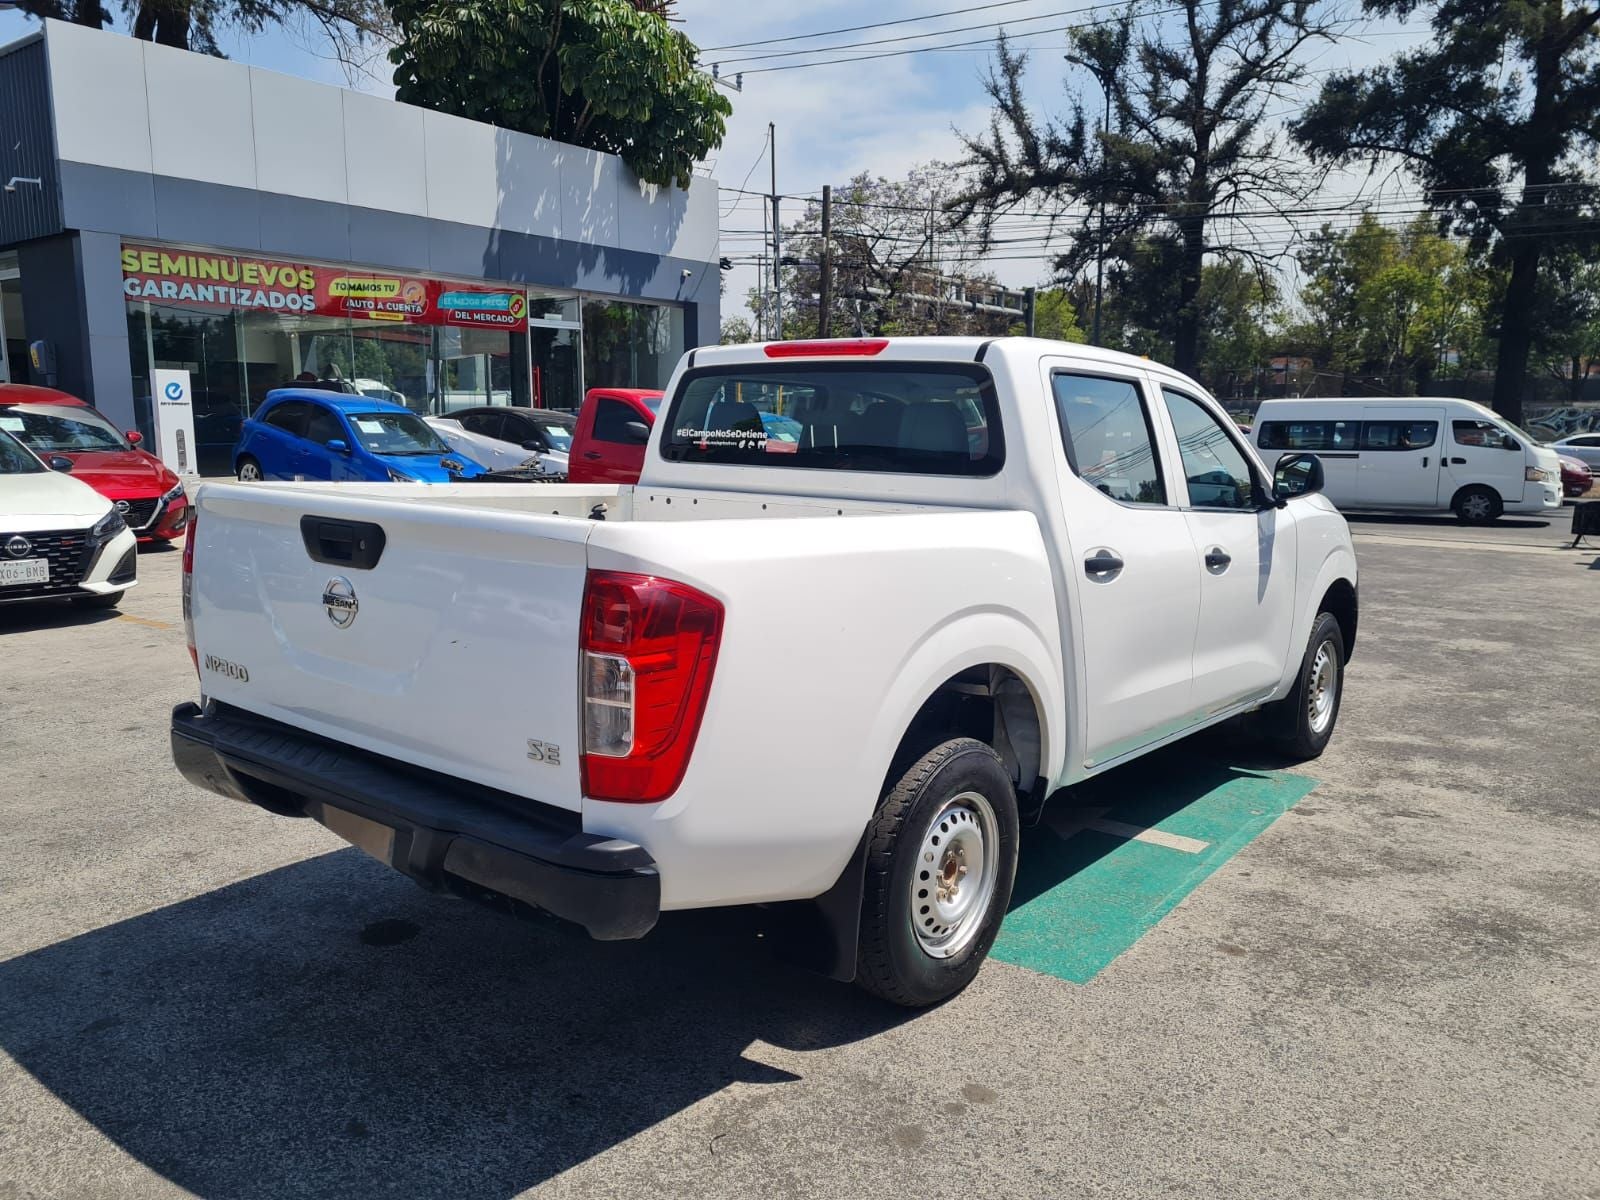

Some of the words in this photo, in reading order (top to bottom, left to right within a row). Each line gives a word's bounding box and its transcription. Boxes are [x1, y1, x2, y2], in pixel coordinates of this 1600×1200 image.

[121, 248, 316, 290] SEMINUEVOS
[123, 276, 316, 311] GARANTIZADOS
[335, 282, 382, 292] TOMAMOS
[383, 284, 396, 293] TU
[347, 299, 375, 309] AUTO
[376, 301, 384, 310] A
[386, 302, 424, 314] CUENTA
[443, 296, 453, 305] EL
[482, 298, 508, 307] PRECIO
[455, 311, 472, 321] DEL
[473, 313, 515, 324] MERCADO
[676, 428, 768, 440] #ElCampoNoSeDetiene
[205, 653, 249, 683] NP300
[527, 738, 561, 766] SE
